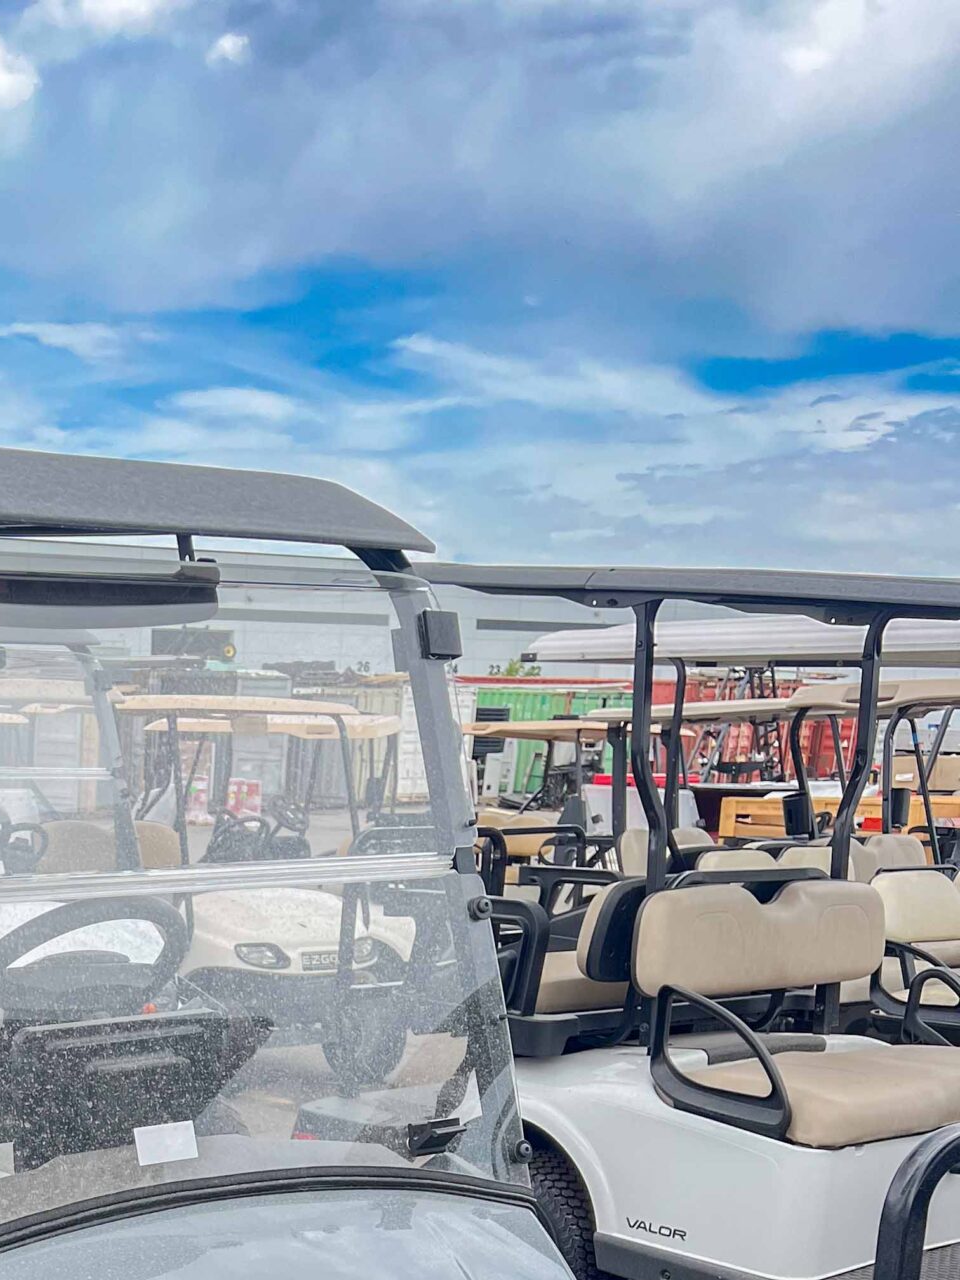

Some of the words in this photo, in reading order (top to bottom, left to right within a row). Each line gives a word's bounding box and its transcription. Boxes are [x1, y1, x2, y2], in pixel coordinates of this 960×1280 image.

[357, 661, 370, 672] 26
[489, 664, 501, 676] 23
[303, 954, 338, 965] EZGO
[626, 1216, 687, 1241] VALOR
